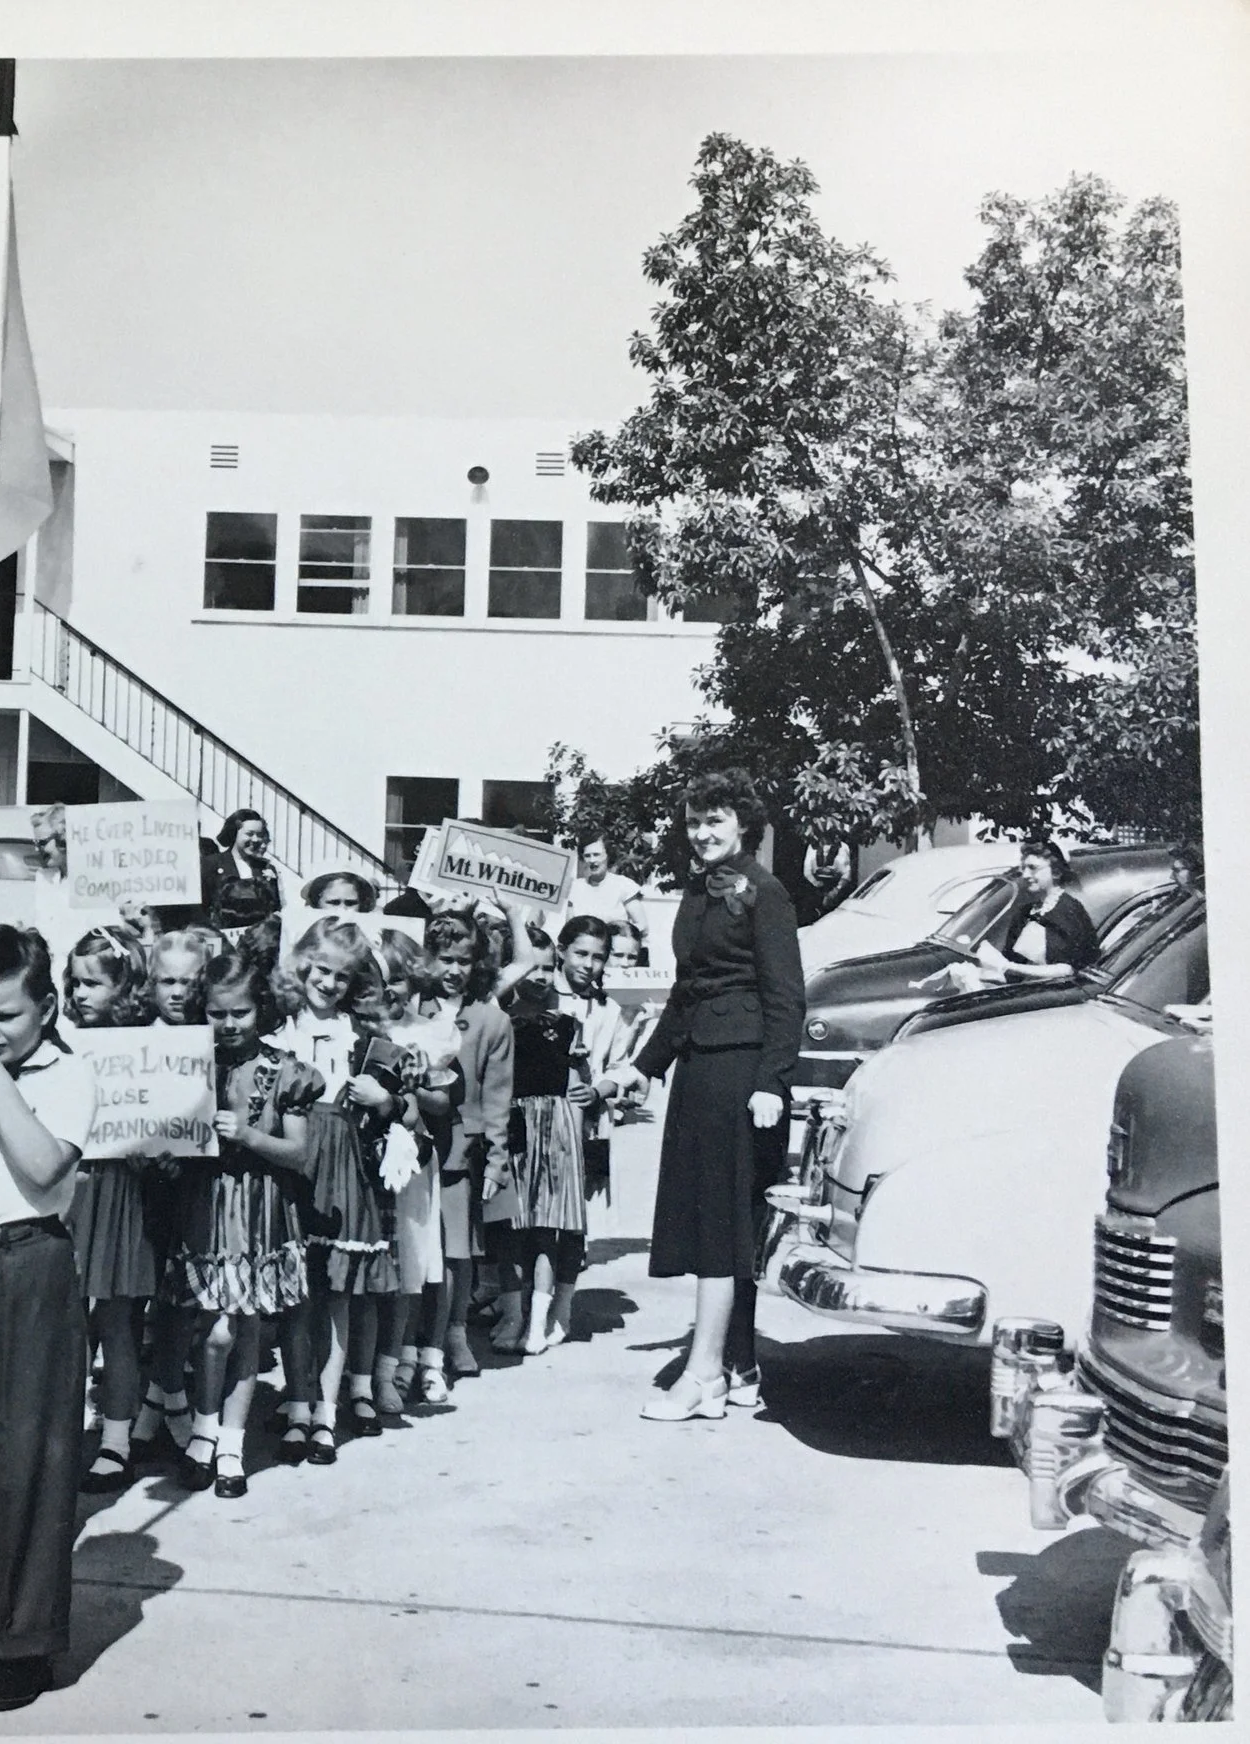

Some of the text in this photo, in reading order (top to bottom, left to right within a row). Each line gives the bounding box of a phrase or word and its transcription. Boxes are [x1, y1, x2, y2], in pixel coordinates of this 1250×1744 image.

[86, 848, 178, 871] IN TENDER
[74, 874, 187, 901] COMPASSION
[444, 855, 560, 900] Mt. Whitney
[82, 1051, 135, 1079] VER
[99, 1087, 149, 1107] LOSE
[88, 1116, 213, 1154] MPANIONSHIP
